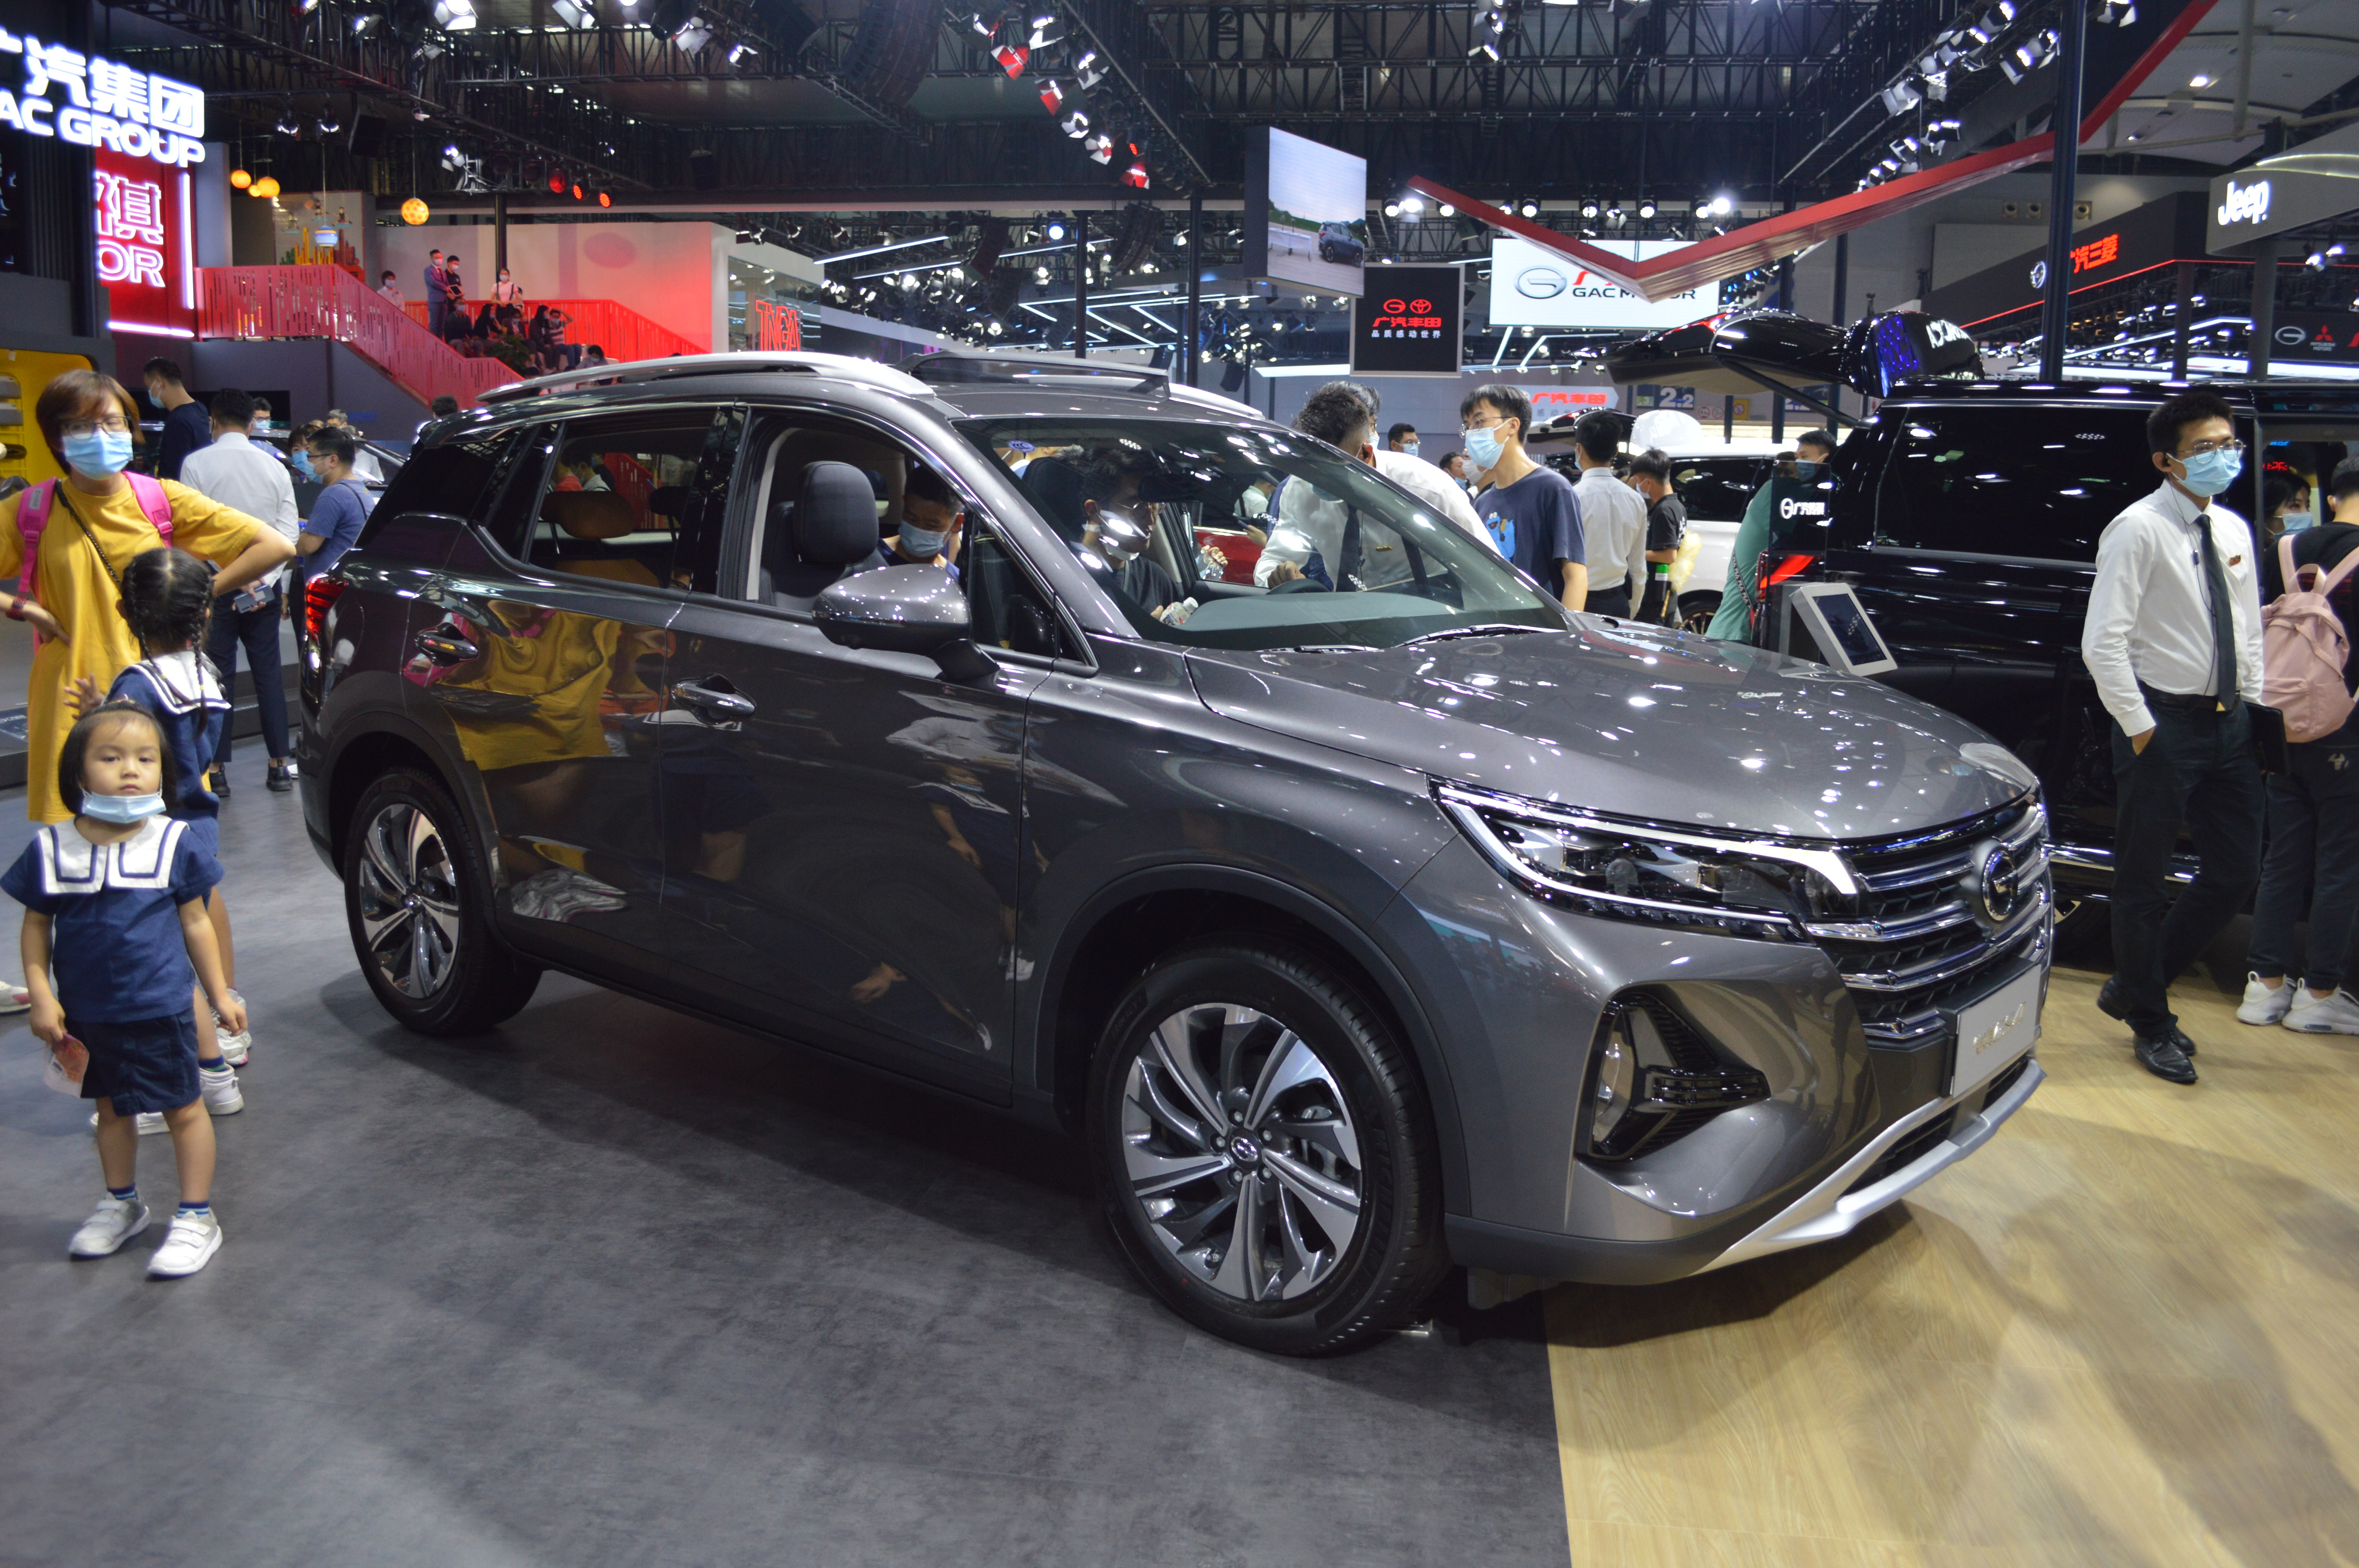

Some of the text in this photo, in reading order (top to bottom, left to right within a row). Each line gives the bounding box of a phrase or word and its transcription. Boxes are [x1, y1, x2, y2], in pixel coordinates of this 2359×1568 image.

[0, 27, 205, 138] 汽集团
[58, 107, 205, 167] GROUP
[2218, 181, 2269, 225] Jeep
[2070, 234, 2118, 273] 汽三菱
[1573, 287, 1615, 298] GAC
[1372, 317, 1441, 327] 广汽丰田
[1531, 392, 1607, 405] 广汽丰田
